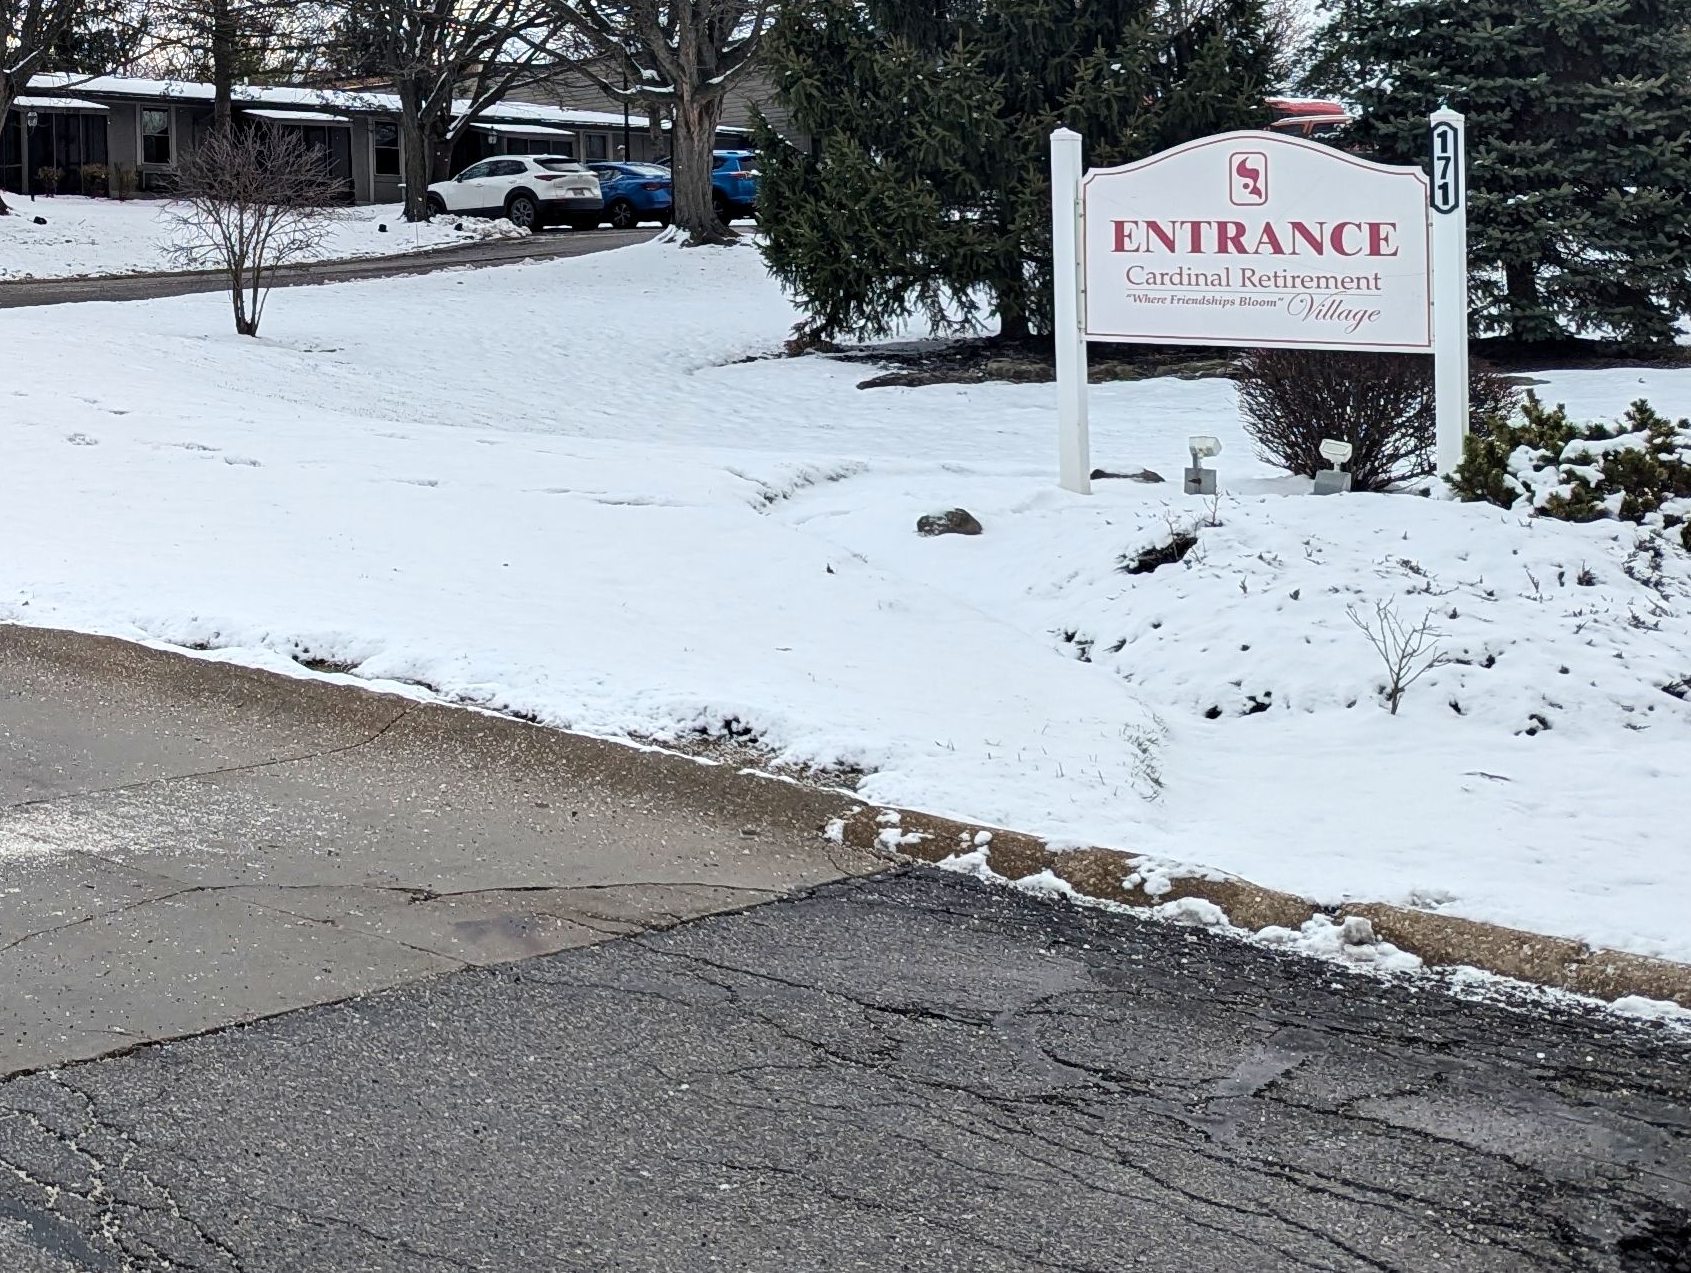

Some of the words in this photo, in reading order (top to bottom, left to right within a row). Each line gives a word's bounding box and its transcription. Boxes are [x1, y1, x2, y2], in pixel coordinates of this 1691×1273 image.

[1436, 129, 1452, 206] 171
[1109, 219, 1400, 257] ENTRANCE
[1125, 264, 1232, 288] Cardinal
[1239, 267, 1382, 291] Retirement
[1170, 294, 1236, 309] Friendships
[1286, 290, 1382, 335] Village
